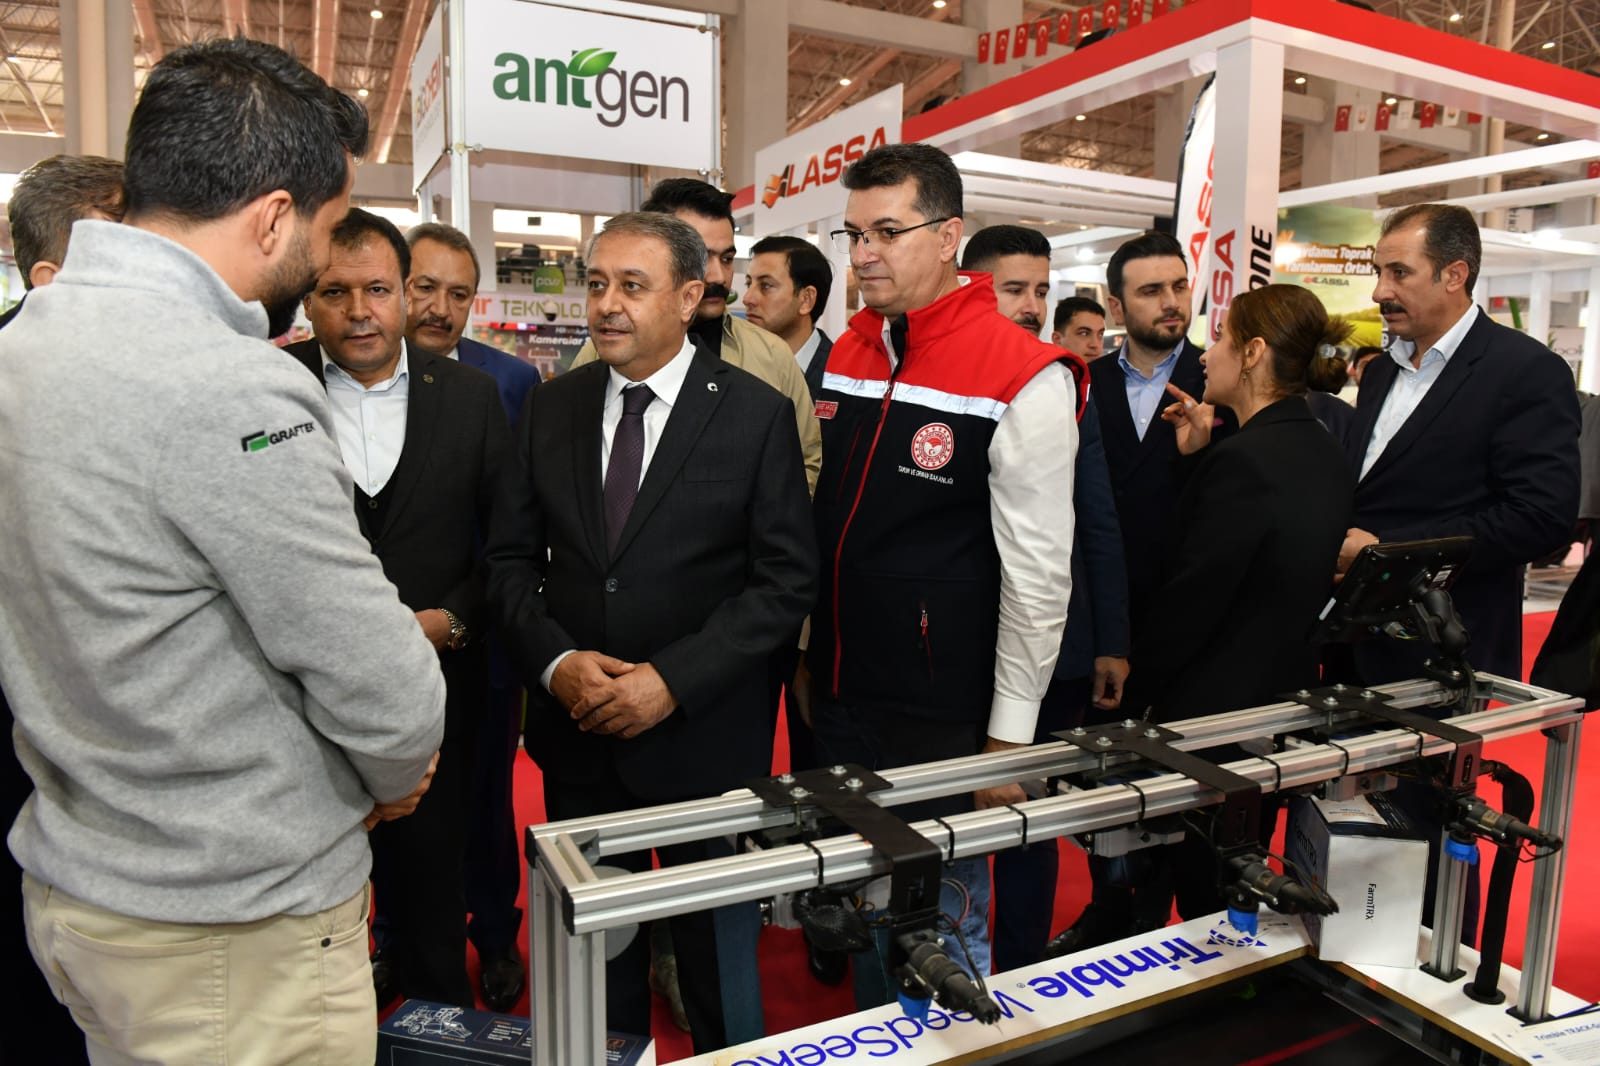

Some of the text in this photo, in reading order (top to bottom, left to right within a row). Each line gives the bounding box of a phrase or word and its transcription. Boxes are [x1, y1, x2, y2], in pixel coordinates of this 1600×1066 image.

[493, 48, 690, 128] antgen
[1345, 262, 1373, 273] Ortak
[269, 421, 316, 445] GRAFTEK
[1365, 883, 1377, 920] FarmTRX
